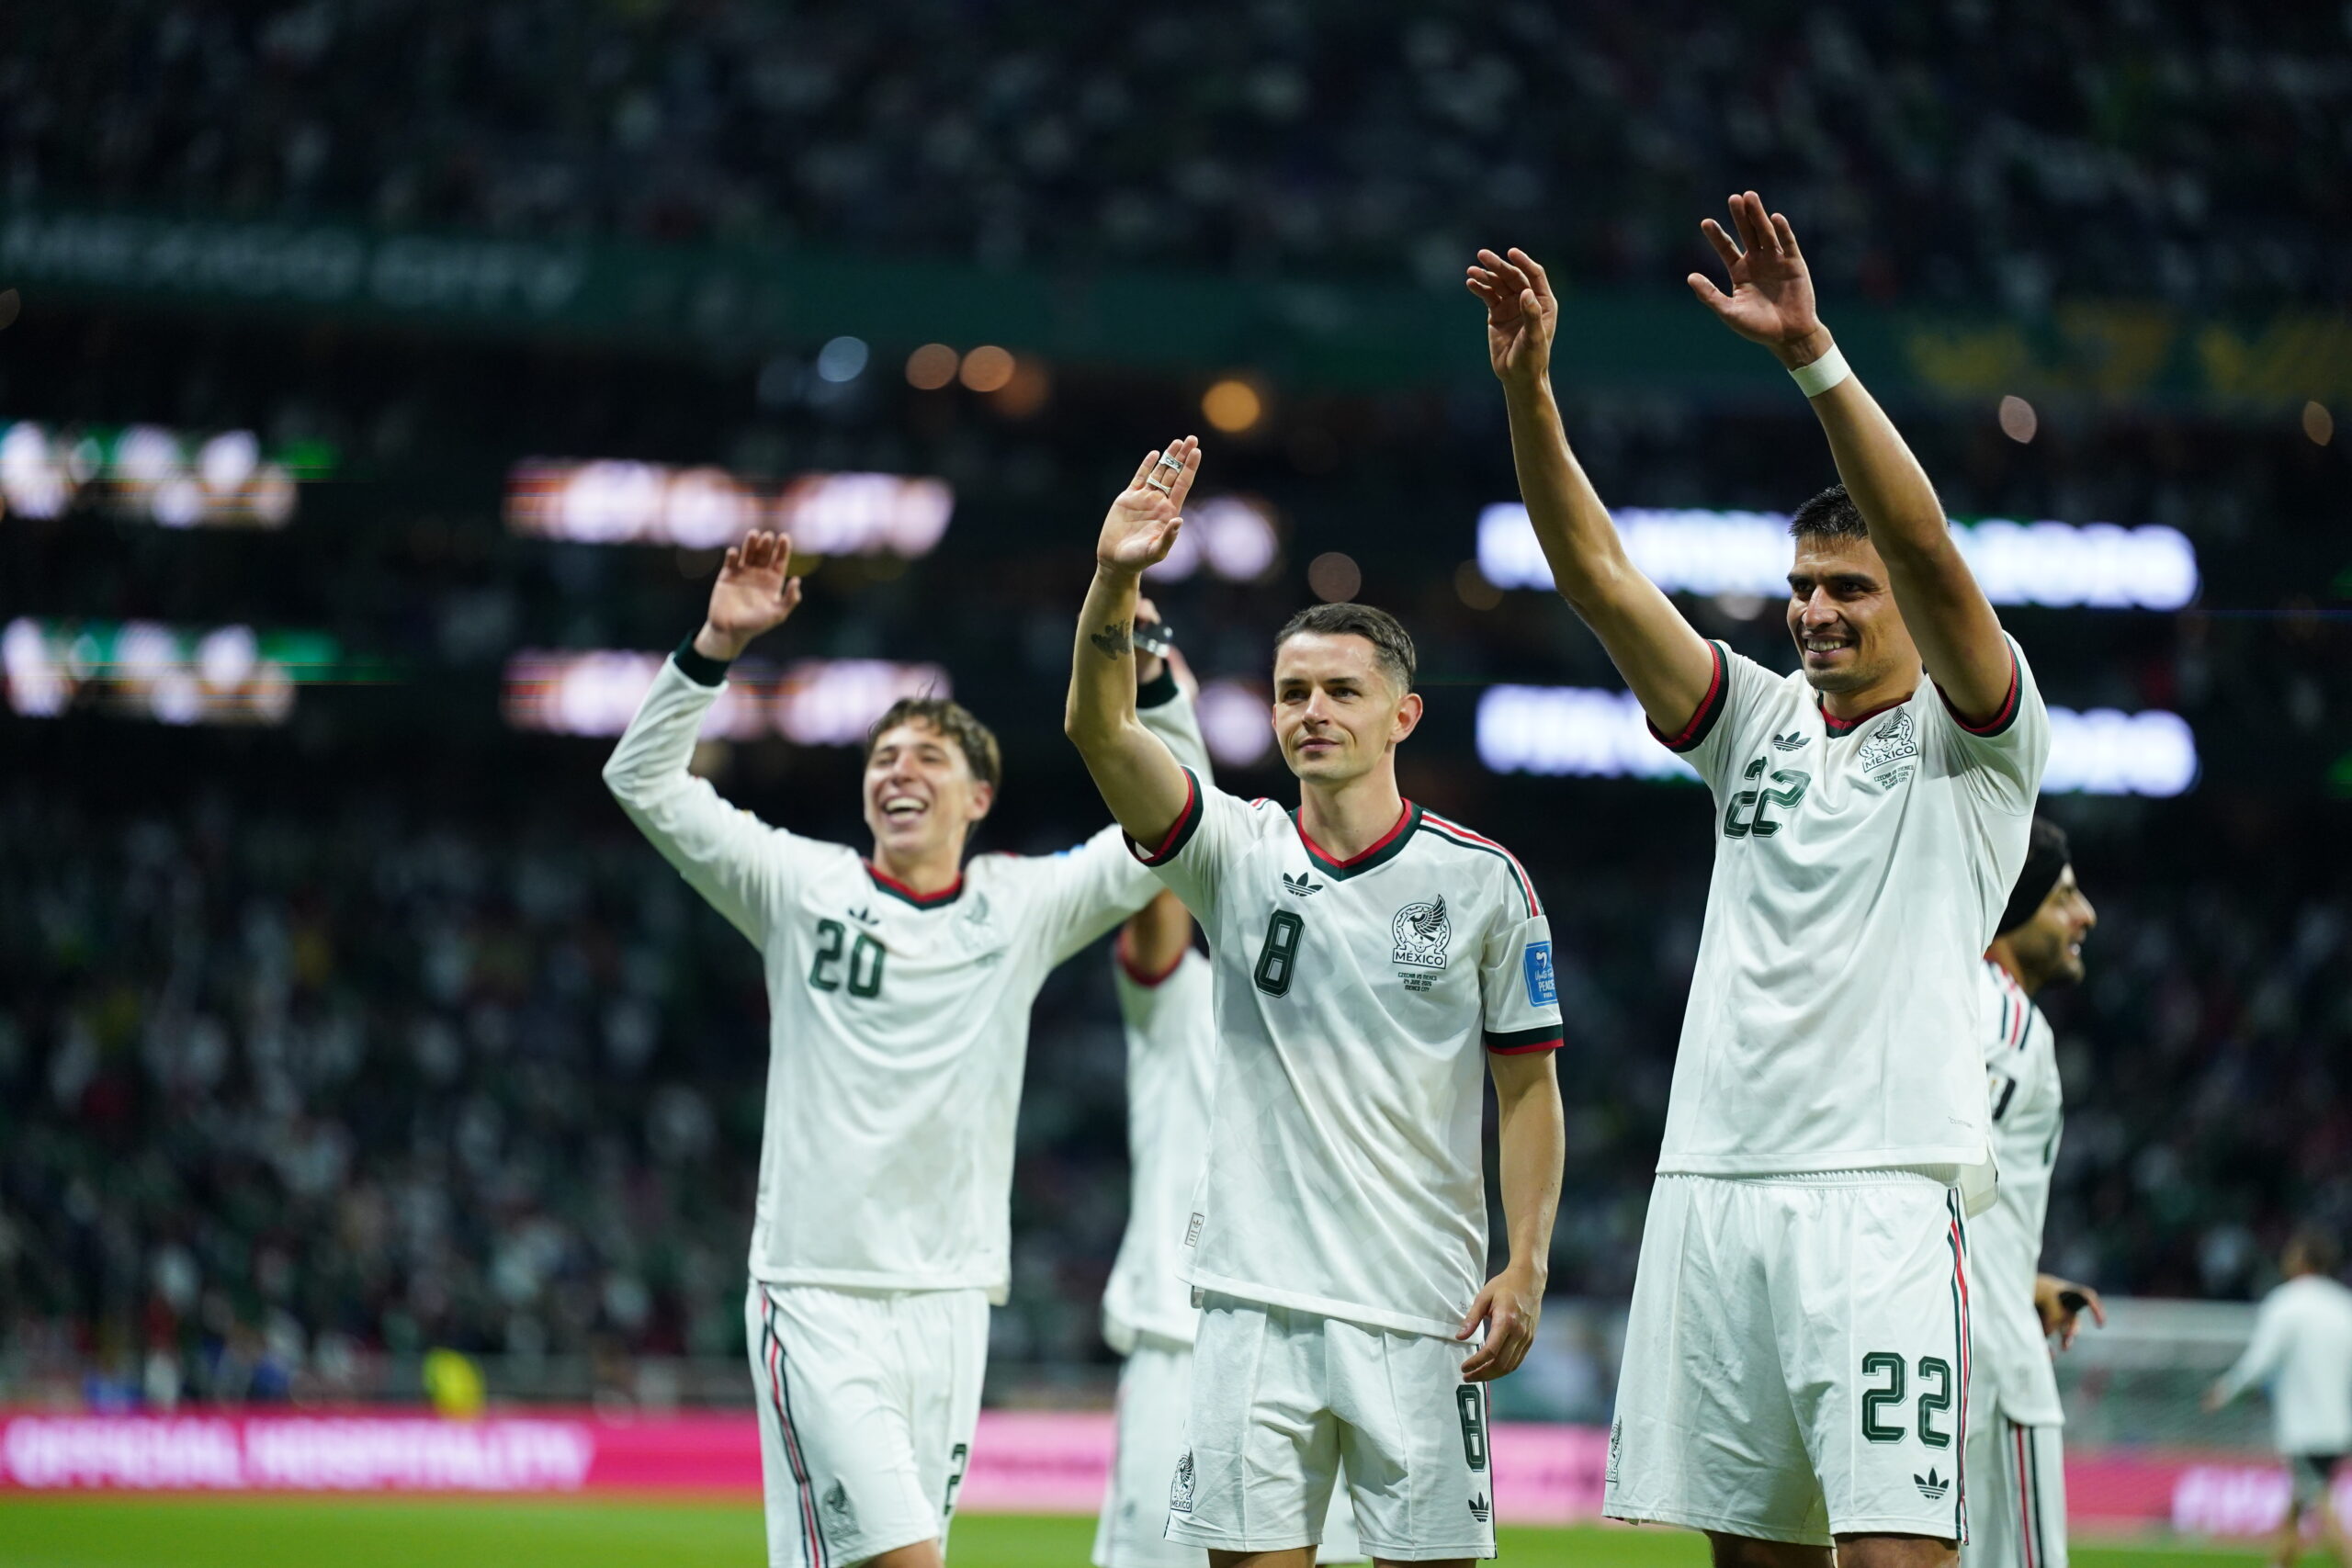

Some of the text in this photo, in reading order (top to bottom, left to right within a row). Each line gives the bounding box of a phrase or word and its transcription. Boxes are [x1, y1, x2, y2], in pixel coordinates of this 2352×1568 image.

[1724, 756, 1812, 840] 22
[810, 919, 887, 998] 20
[1254, 909, 1306, 998] 8
[1396, 950, 1443, 965] MÉXICO
[1455, 1384, 1486, 1472] 8
[1861, 1352, 1951, 1449] 22
[4, 1416, 595, 1490] OFFICIAL HOSPITALITY
